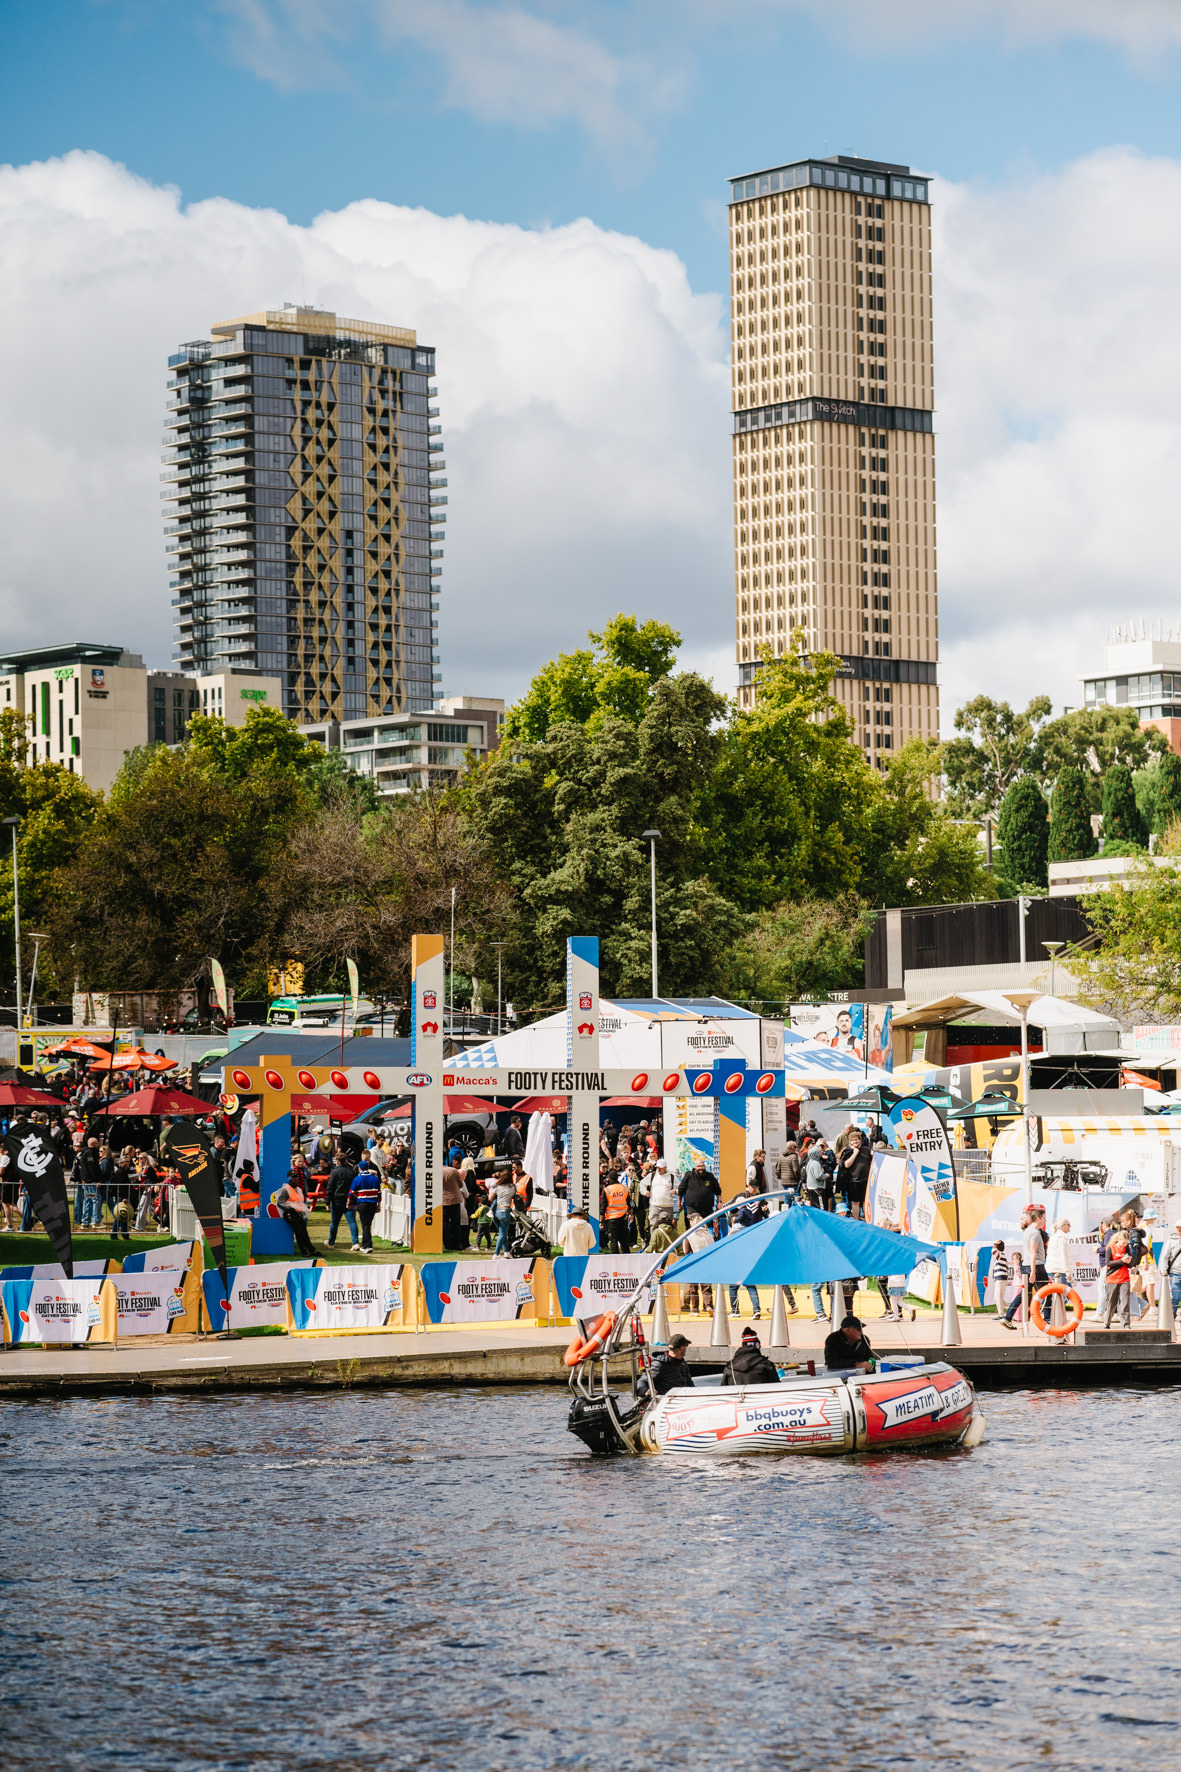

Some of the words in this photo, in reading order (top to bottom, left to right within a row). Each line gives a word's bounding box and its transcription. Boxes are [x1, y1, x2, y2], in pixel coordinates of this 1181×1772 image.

[815, 401, 829, 412] The
[240, 689, 267, 703] scape
[687, 1036, 707, 1046] FOOTY
[708, 1036, 735, 1046] FESTIVAL
[407, 1074, 432, 1086] AFL
[456, 1076, 498, 1086] Macca's
[508, 1072, 548, 1091] FOOTY
[551, 1072, 607, 1091] FESTIVAL
[916, 1128, 943, 1140] FREE
[425, 1121, 433, 1168] ROUND
[582, 1122, 590, 1169] ROUND
[909, 1140, 943, 1153] ENTRY
[188, 1162, 209, 1179] ADELAIDE
[425, 1172, 433, 1226] GATHER
[582, 1172, 590, 1214] ATHER
[1076, 1268, 1099, 1279] FESTIVA
[458, 1284, 479, 1295] FOOTY
[480, 1283, 511, 1294] FESTIVAL
[590, 1279, 611, 1290] FOOTY
[613, 1278, 641, 1289] FESTIVA
[238, 1289, 261, 1302] FOOTY
[262, 1287, 286, 1300] FESTIV
[323, 1290, 346, 1302] FOOTY
[347, 1289, 378, 1300] FESTIVAL
[35, 1303, 55, 1314] FOOTY
[56, 1303, 82, 1314] FESTIVAL
[130, 1297, 162, 1309] FESTIVAL
[583, 1403, 607, 1412] SUZU
[895, 1392, 935, 1418] MEATIN'
[945, 1395, 951, 1409] &
[746, 1406, 812, 1422] bbqbuoys
[753, 1418, 806, 1432] .com.au
